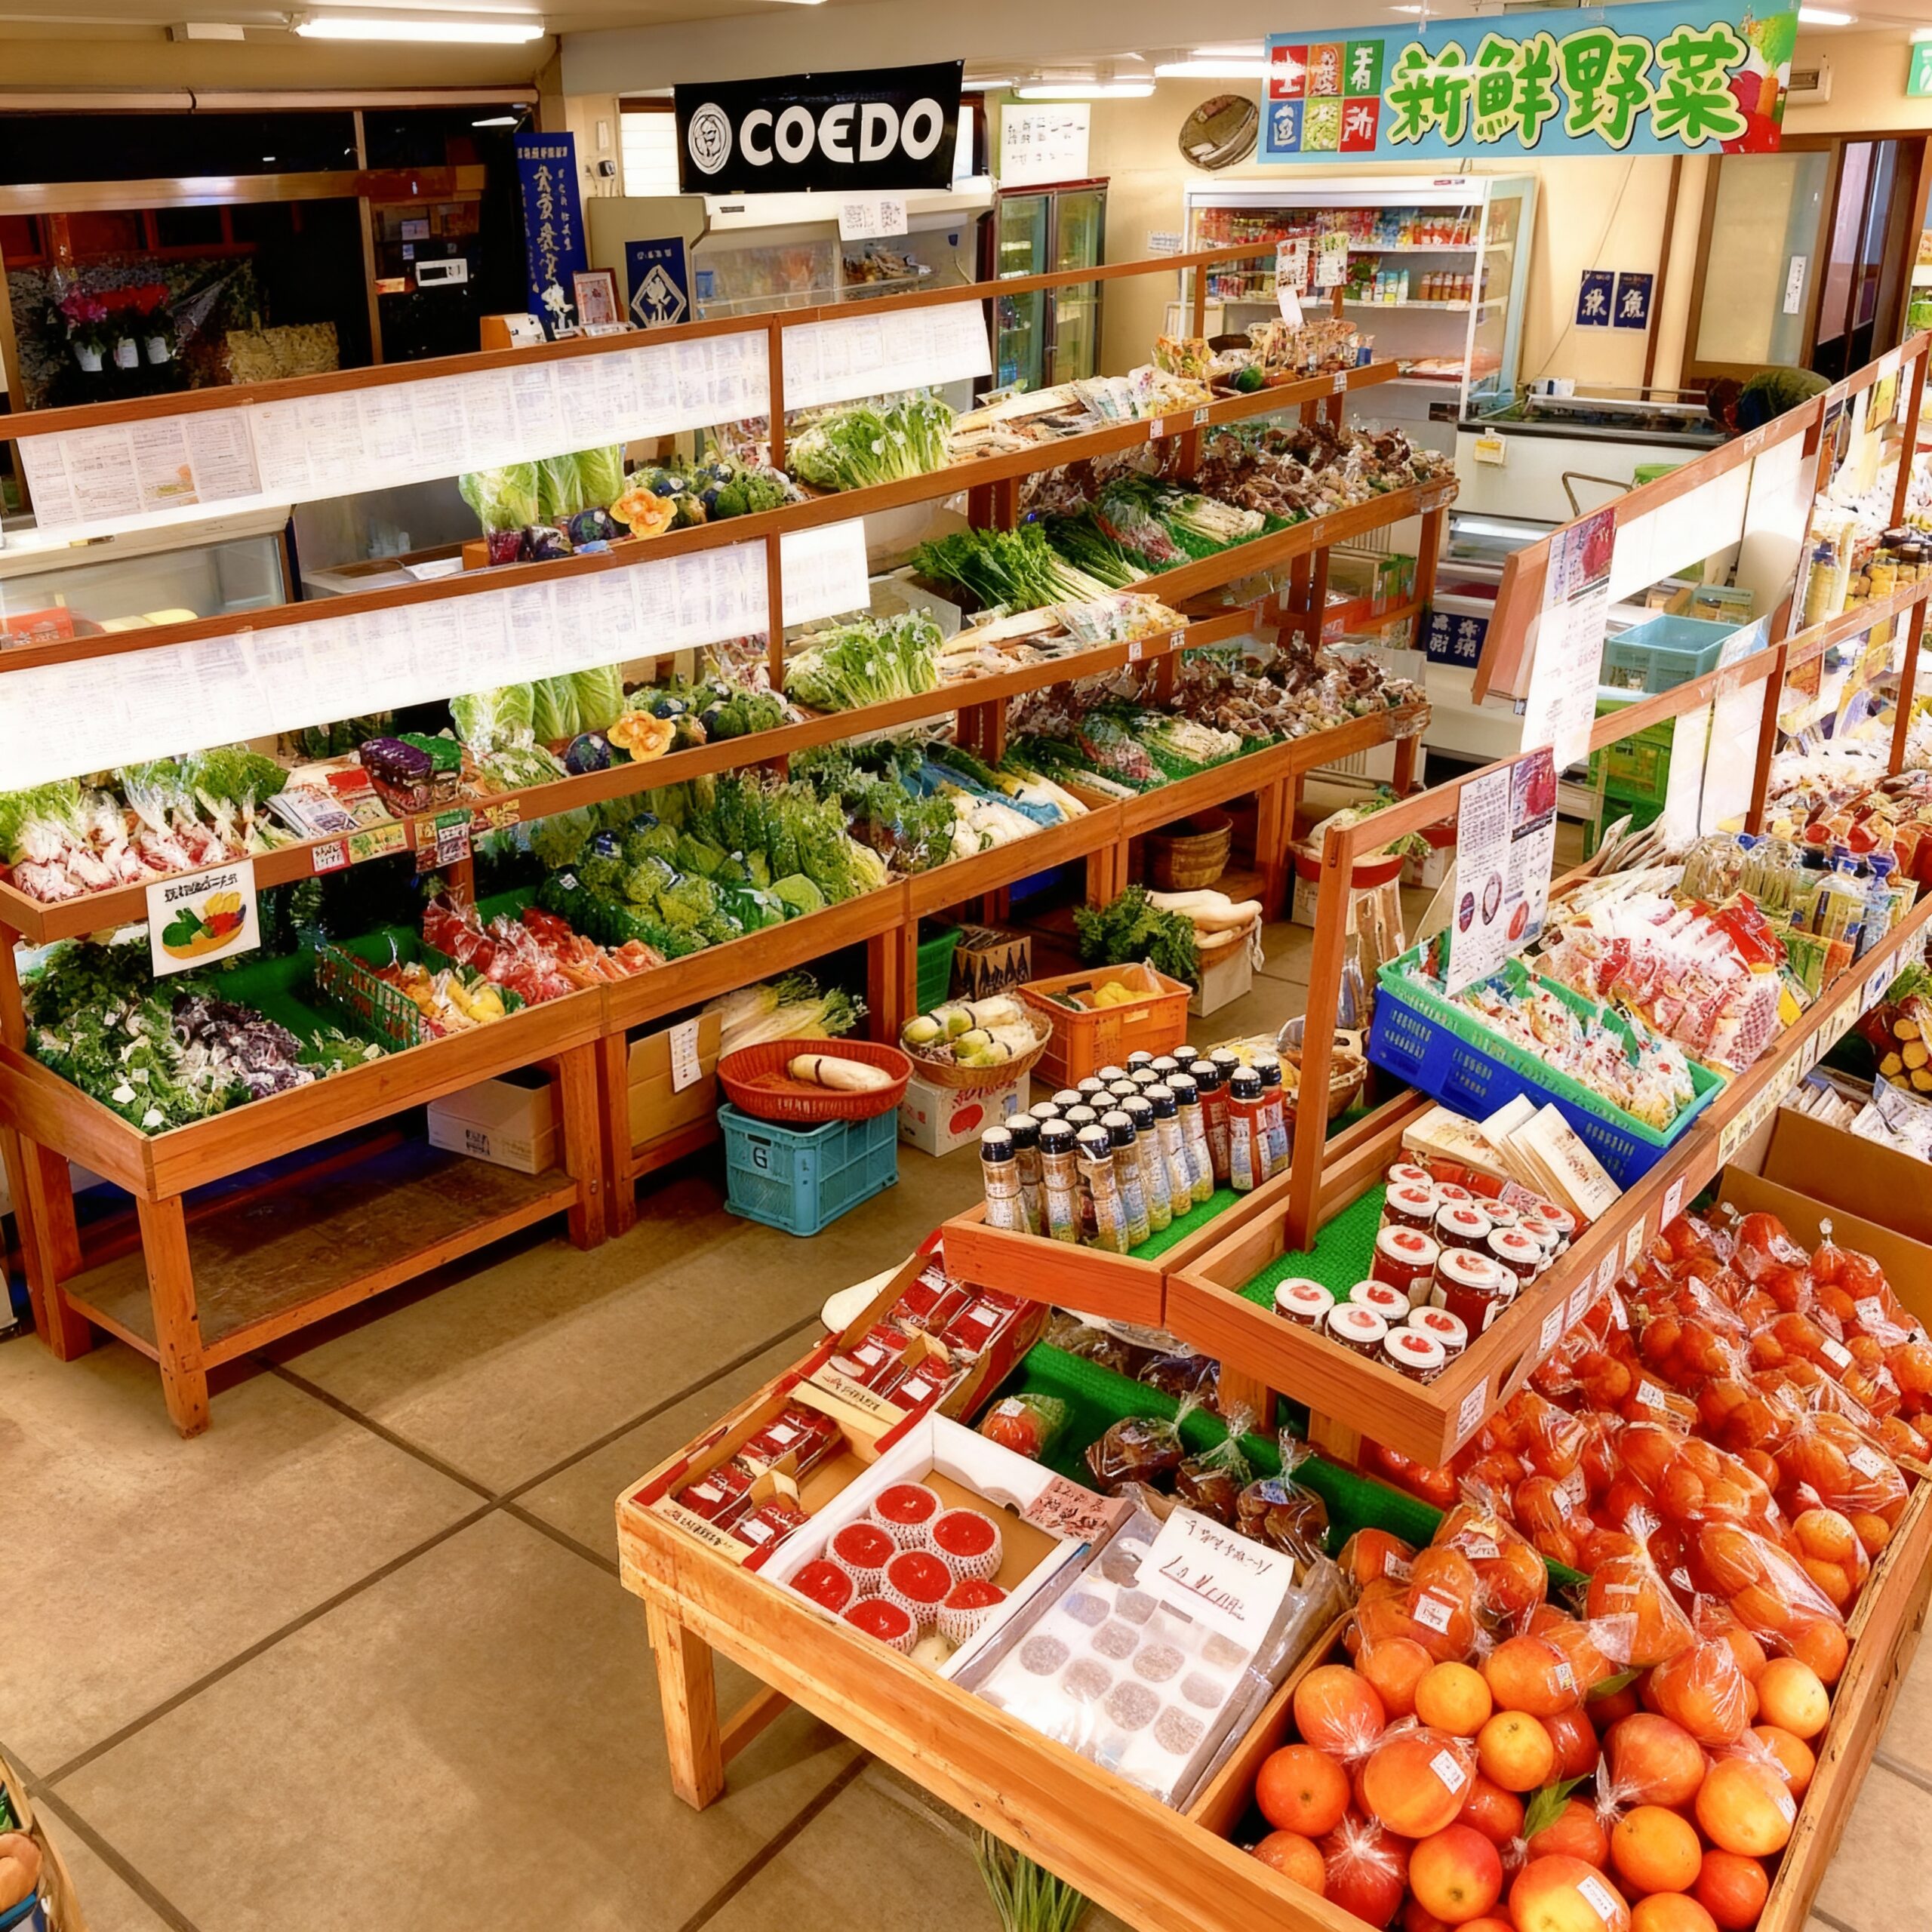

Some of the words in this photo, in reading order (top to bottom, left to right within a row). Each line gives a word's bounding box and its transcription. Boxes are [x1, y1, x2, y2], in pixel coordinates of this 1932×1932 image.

[740, 98, 943, 166] COEDO
[1387, 26, 1744, 146] 新鮮野菜
